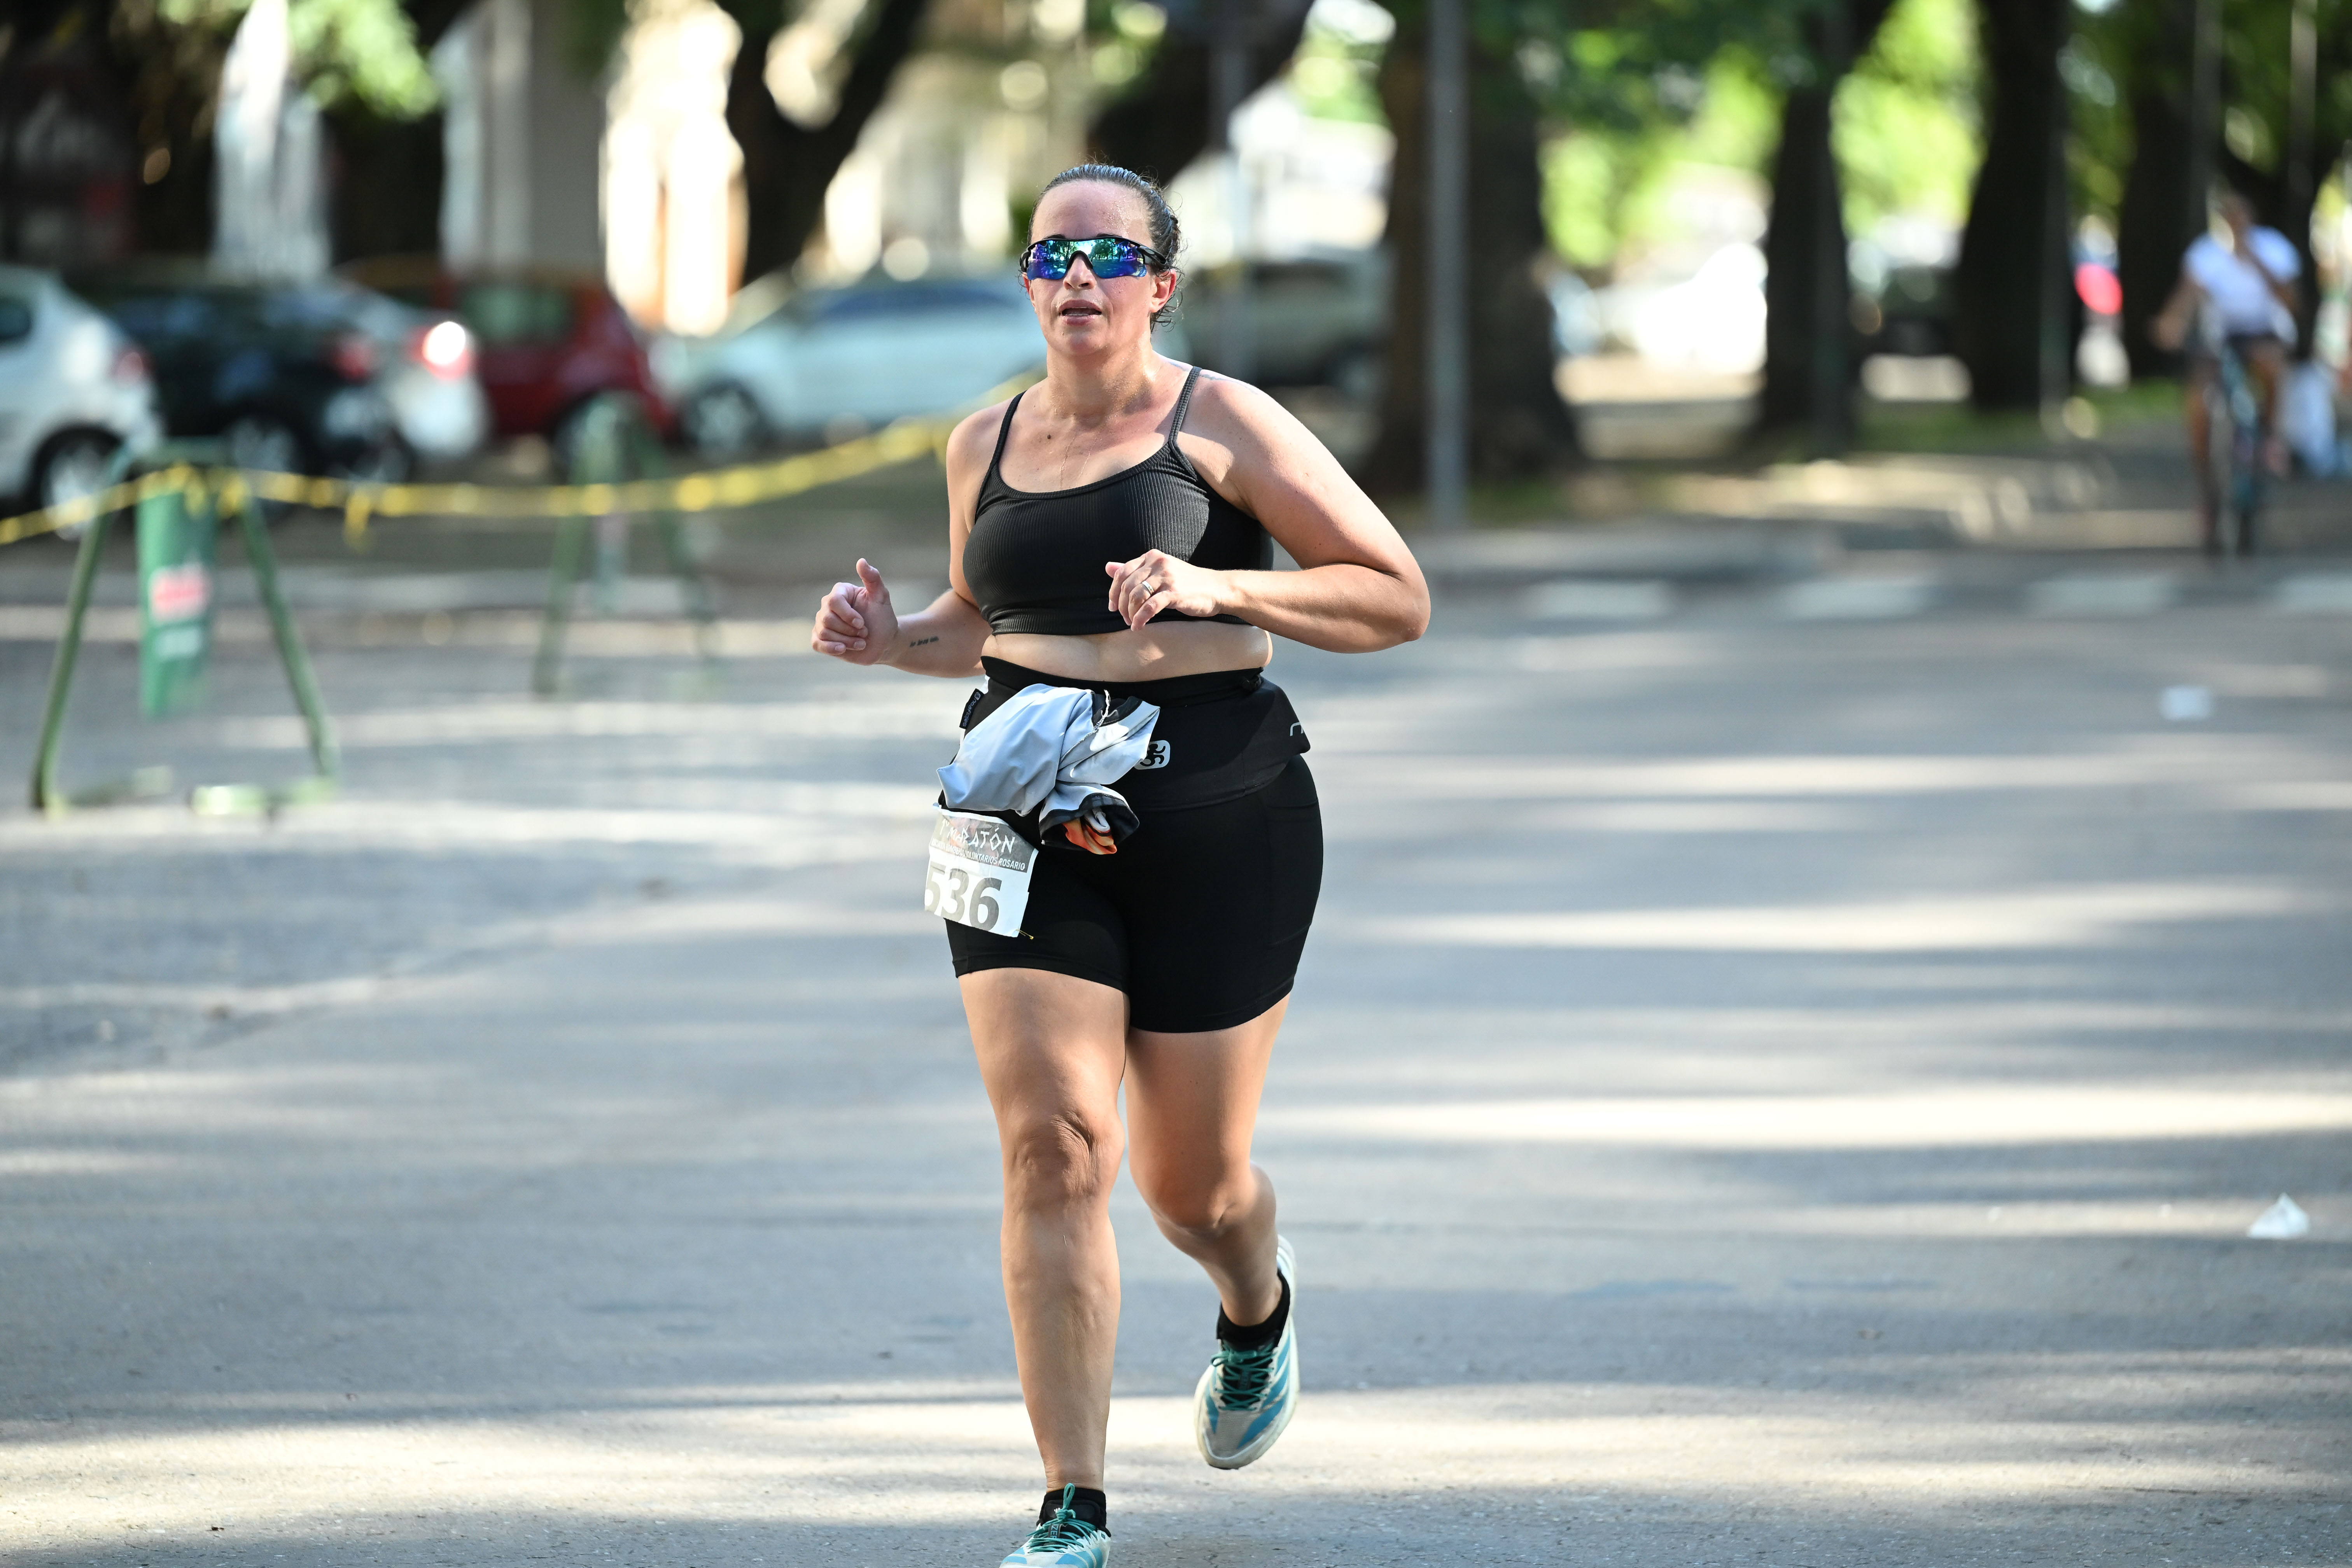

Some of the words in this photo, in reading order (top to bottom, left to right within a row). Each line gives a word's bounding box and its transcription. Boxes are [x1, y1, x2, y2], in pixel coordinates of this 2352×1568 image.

[947, 824, 1015, 854] MARATÓN
[965, 850, 998, 864] VOLUNTARIOS
[998, 858, 1026, 871] ROSARIO
